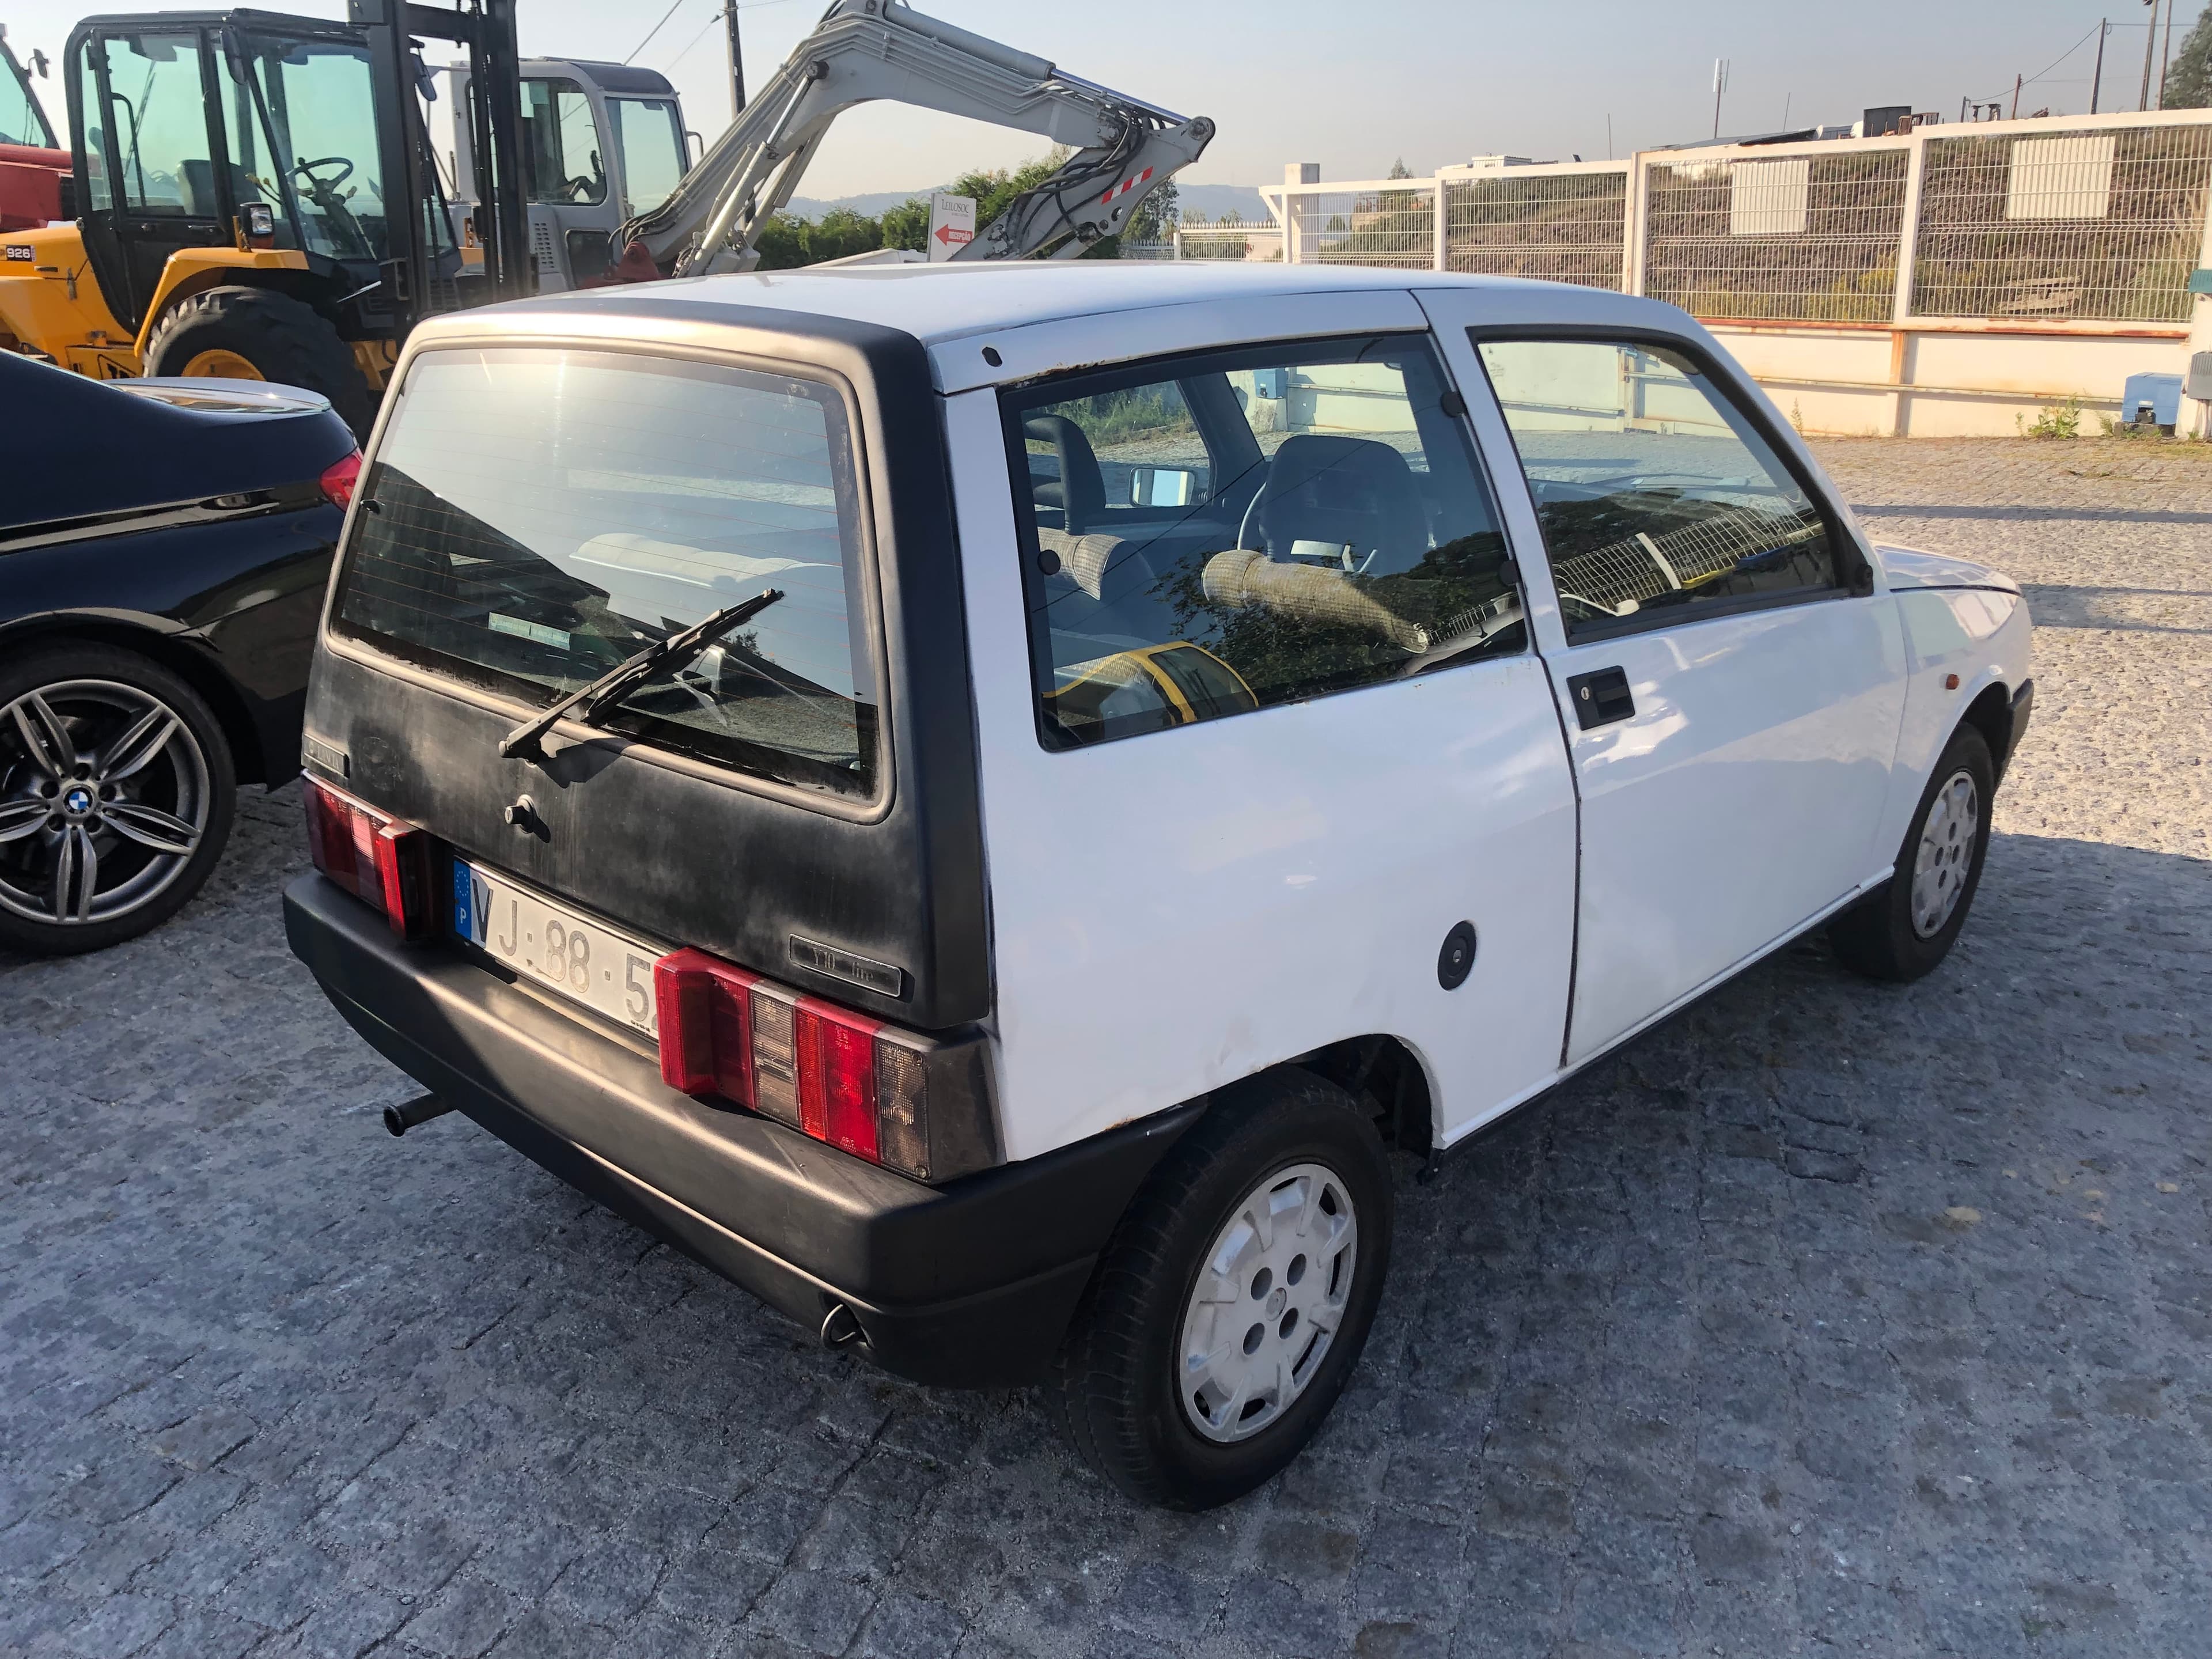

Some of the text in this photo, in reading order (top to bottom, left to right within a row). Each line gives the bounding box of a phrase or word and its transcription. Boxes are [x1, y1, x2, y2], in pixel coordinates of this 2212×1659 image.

[7, 248, 31, 259] 926
[460, 907, 467, 924] P
[812, 947, 835, 971] Y10
